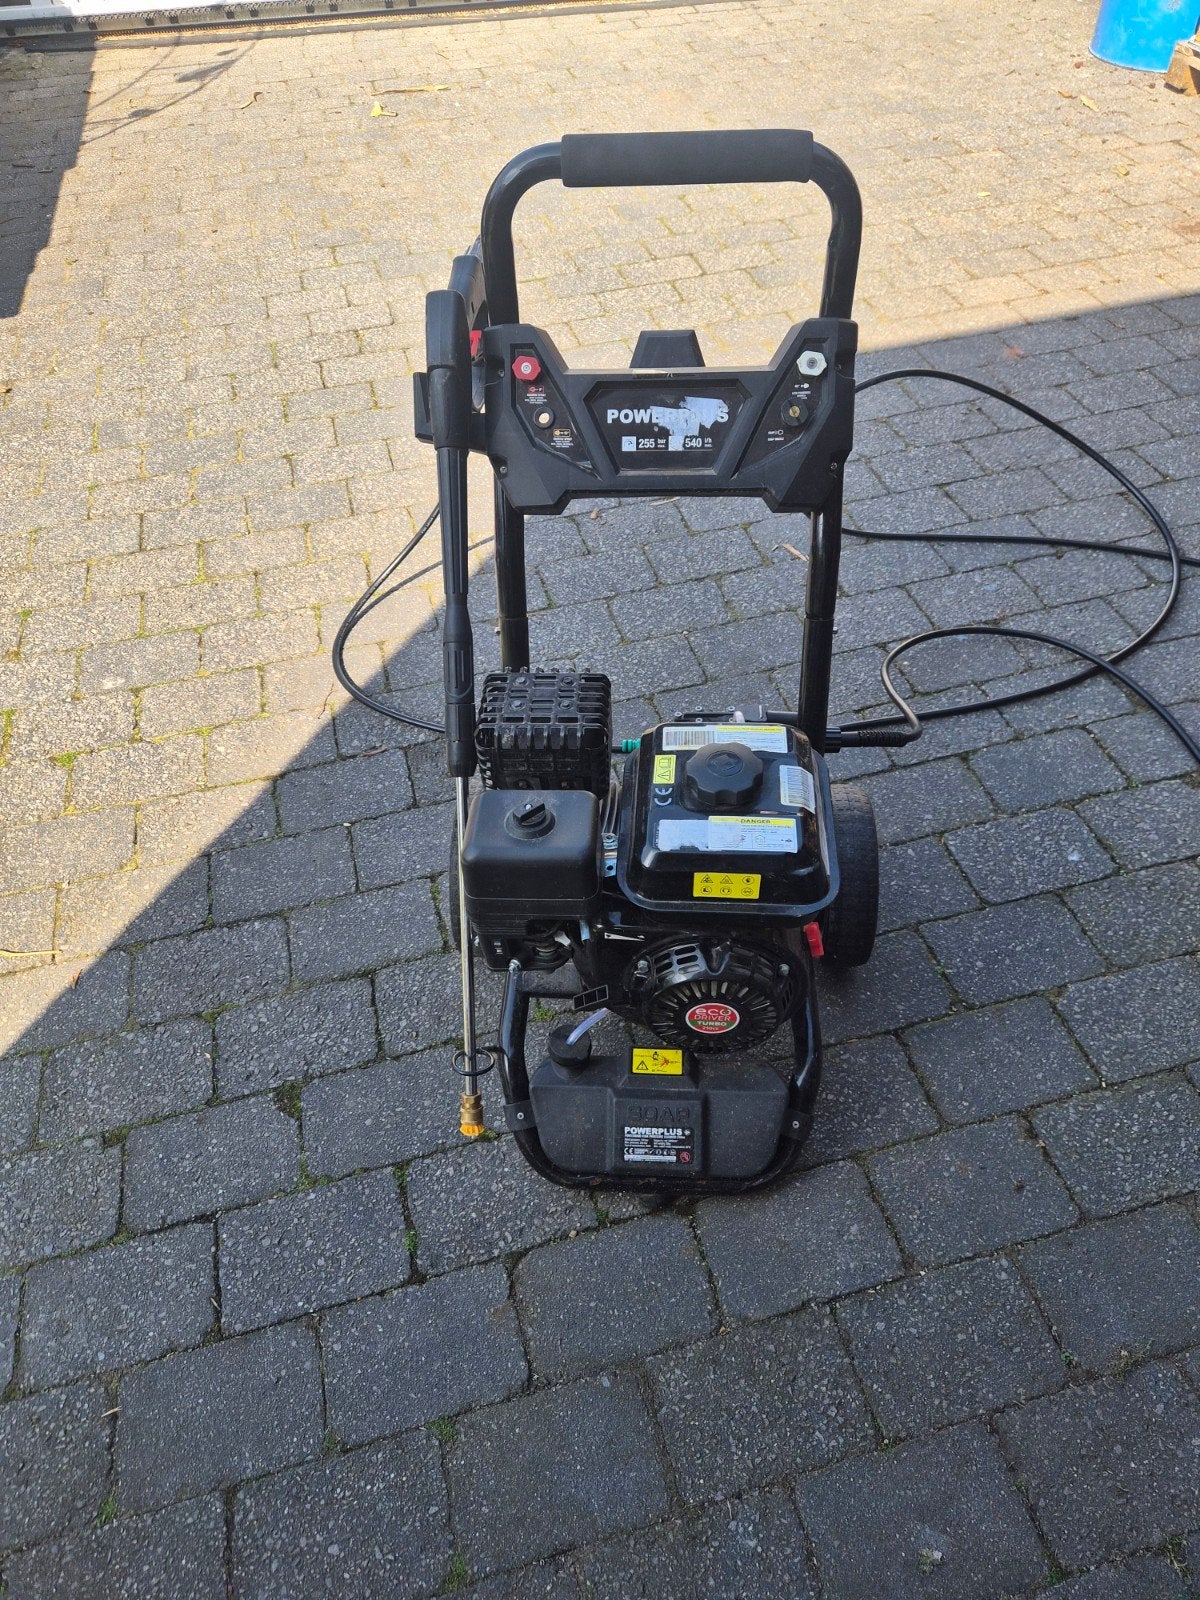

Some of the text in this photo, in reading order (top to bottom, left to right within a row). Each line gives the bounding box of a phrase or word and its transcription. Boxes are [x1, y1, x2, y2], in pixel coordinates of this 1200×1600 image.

[638, 438, 655, 448] 255
[685, 438, 702, 448] 540
[695, 1008, 731, 1016] eco
[624, 1126, 683, 1136] POWERPLUS
